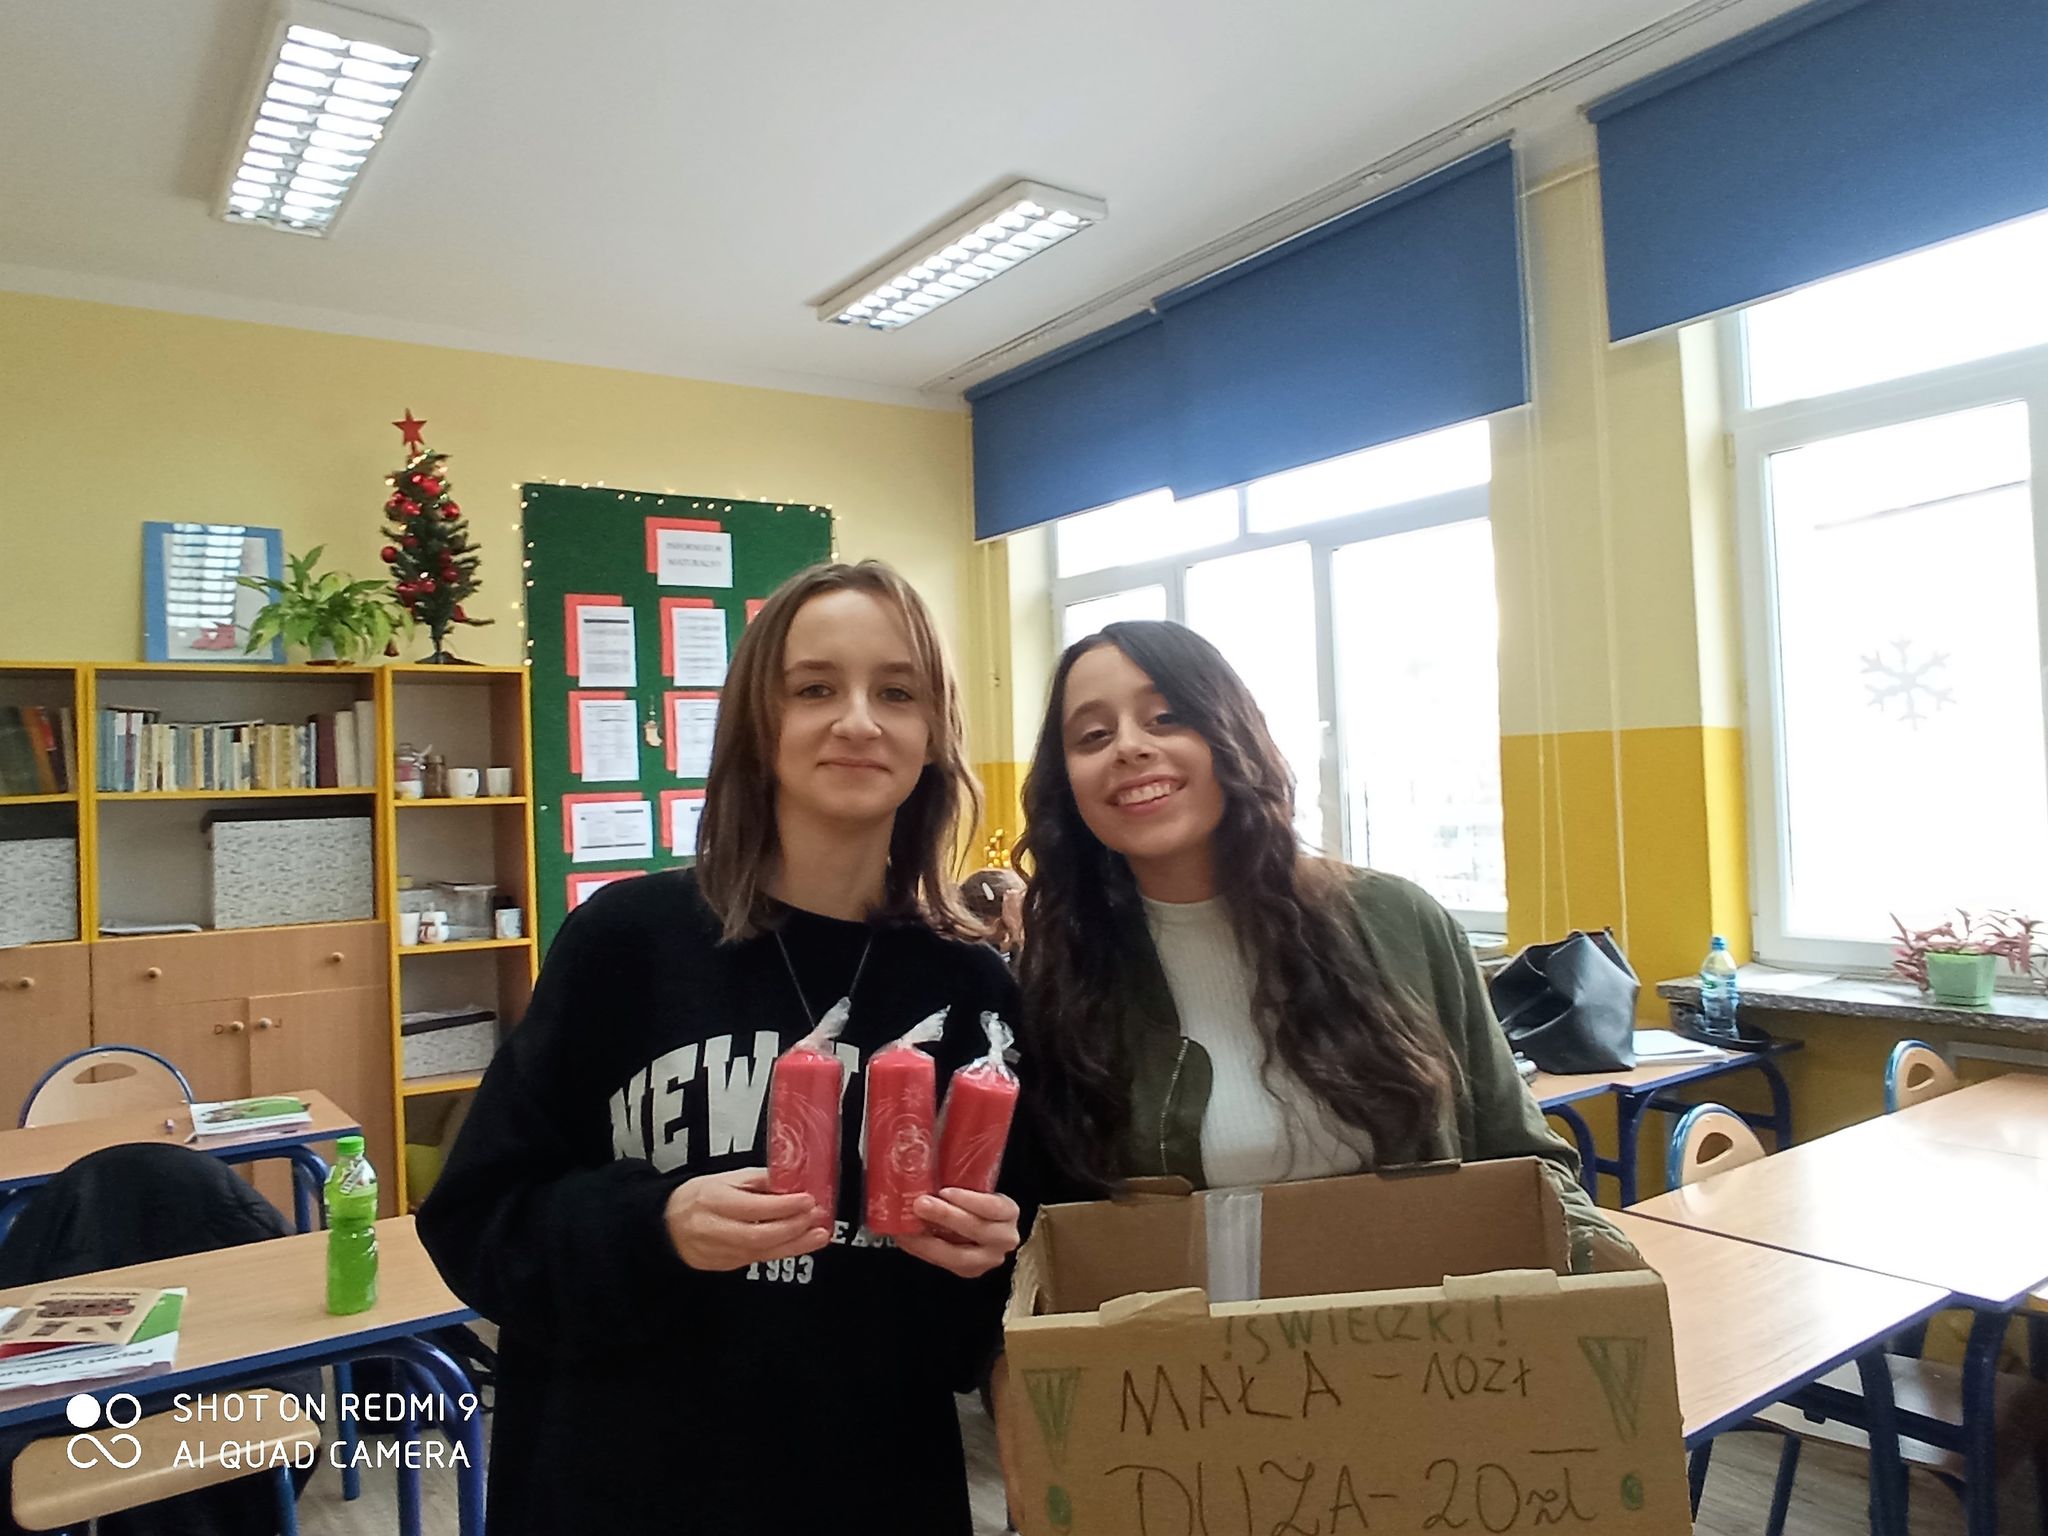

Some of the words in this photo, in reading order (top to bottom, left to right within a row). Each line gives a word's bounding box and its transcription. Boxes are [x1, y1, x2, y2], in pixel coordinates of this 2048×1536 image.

[609, 1030, 779, 1174] NEW
[746, 1254, 815, 1284] 1993
[1120, 1350, 1341, 1436] MAŁA
